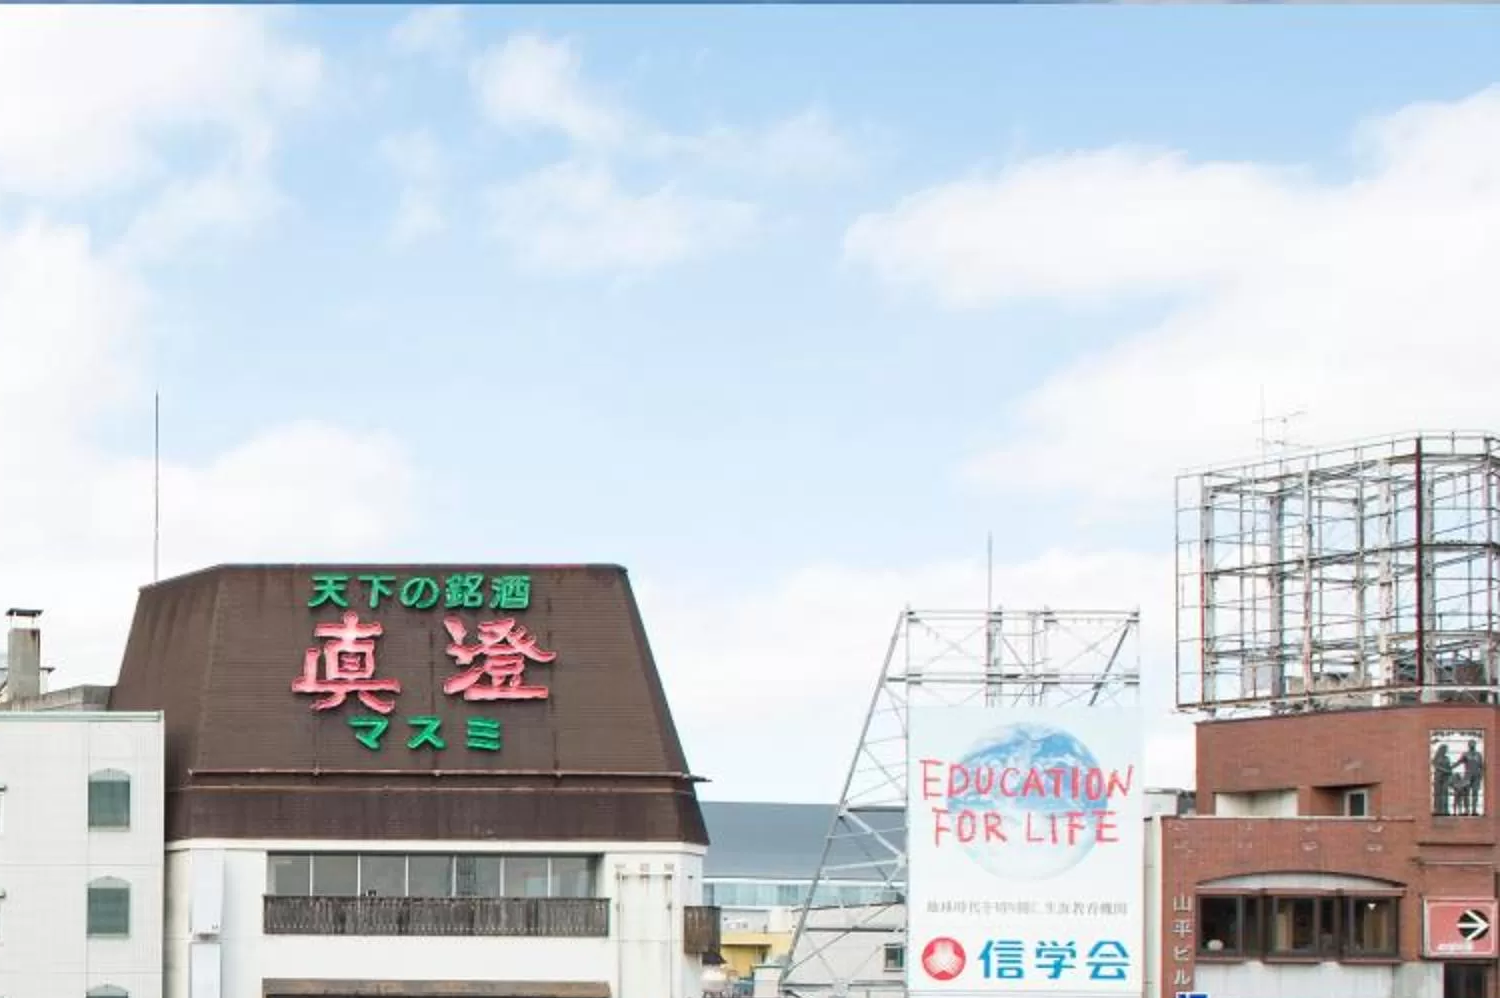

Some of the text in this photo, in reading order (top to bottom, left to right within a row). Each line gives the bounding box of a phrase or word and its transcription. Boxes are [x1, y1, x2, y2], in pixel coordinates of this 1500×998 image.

[308, 573, 532, 609] 天下の銘酒
[348, 715, 502, 750] マスミ
[920, 759, 1135, 801] EDUCATION
[931, 807, 1120, 848] FOR LIFE
[978, 940, 1131, 981] 信学会
